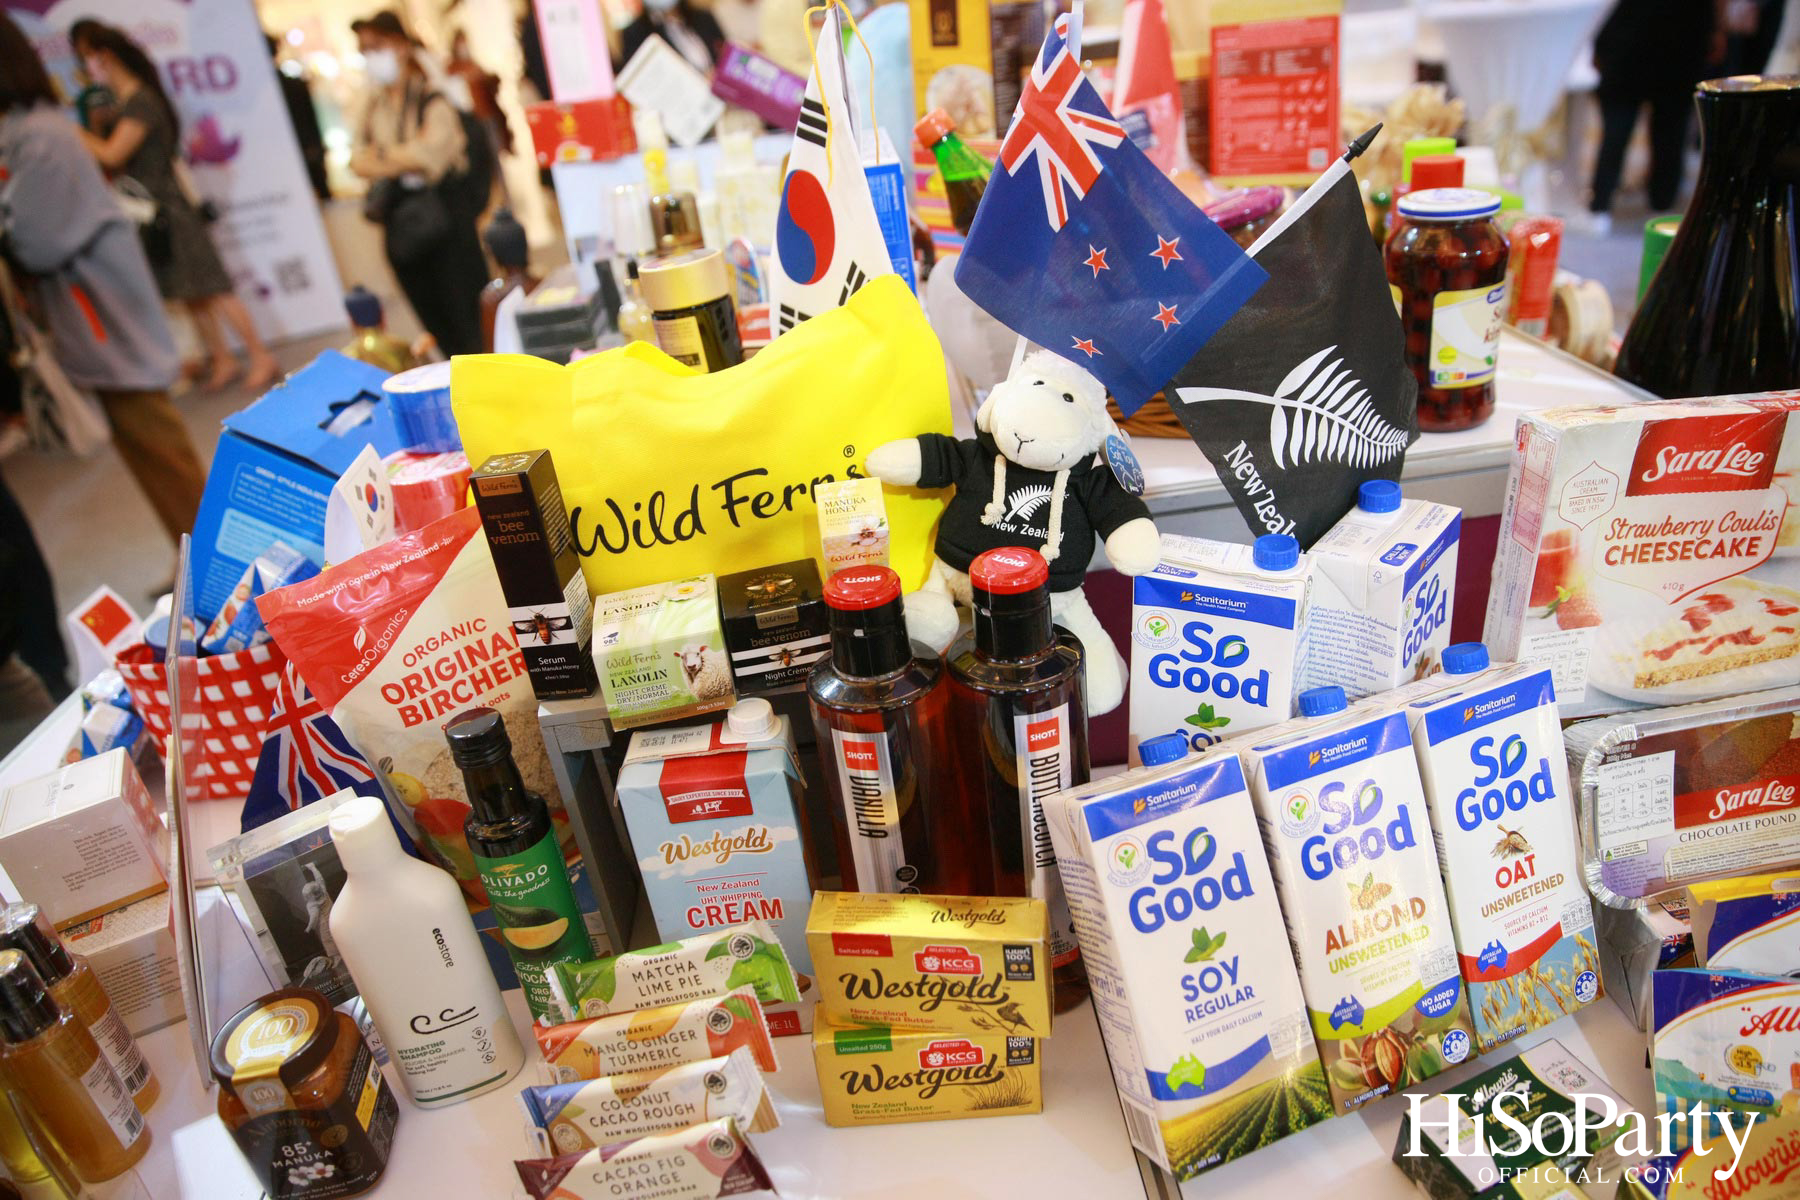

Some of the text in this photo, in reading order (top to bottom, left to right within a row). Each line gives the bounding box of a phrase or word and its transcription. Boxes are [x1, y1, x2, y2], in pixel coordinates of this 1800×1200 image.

[1223, 440, 1267, 497] New
[1642, 441, 1765, 483] Sara Lee
[1572, 478, 1609, 489] AUSTRALIAN
[824, 496, 867, 508] MANUKA
[825, 505, 857, 515] HONEY
[497, 520, 525, 532] bee
[570, 484, 707, 558] Wild
[1604, 509, 1779, 543] Strawberry Coulis
[490, 531, 540, 545] venom
[991, 553, 1028, 568] SHOTT
[1604, 536, 1762, 567] CHEESECAKE
[297, 591, 326, 608] Made
[326, 581, 348, 596] with
[349, 572, 370, 587] care
[381, 558, 403, 573] New
[403, 542, 440, 563] Zealand
[843, 574, 883, 584] SHOTT
[603, 600, 660, 616] LANOLIN
[1195, 593, 1247, 610] Sanitarium
[751, 629, 811, 647] bee venom
[1402, 589, 1448, 669] Good
[402, 617, 488, 668] ORGANIC
[538, 656, 566, 665] Serum
[611, 669, 669, 689] LANOLIN
[765, 669, 787, 681] Night
[1148, 653, 1270, 708] Good
[397, 652, 528, 728] BIRCHER
[488, 691, 511, 707] oats
[614, 688, 641, 698] NIGHT
[1475, 693, 1516, 715] Sanitarium
[1321, 736, 1368, 759] Sanitarium
[1146, 782, 1197, 806] Sanitarium
[1455, 757, 1557, 832] Good
[1708, 780, 1796, 820] Sara Lee
[849, 775, 889, 839] VANILLA
[1679, 812, 1797, 843] CHOCOLATE POUND
[660, 827, 774, 865] Westgold
[1301, 804, 1417, 881] Good
[481, 864, 548, 889] OLIVADO
[1495, 853, 1536, 889] OAT
[503, 888, 518, 898] the
[517, 877, 551, 900] goodness
[697, 877, 761, 894] New Zealand
[1128, 851, 1255, 934] Good
[1481, 873, 1565, 919] UNSWEETENED
[701, 891, 763, 905] UHT WHIPPING
[686, 898, 784, 929] CREAM
[931, 907, 1007, 928] Westgold
[1503, 905, 1549, 930] SOURCE CALCIUM
[1325, 896, 1427, 956] ALMOND
[432, 927, 454, 968] ecostore
[1006, 953, 1031, 961] 100%
[1329, 925, 1431, 975] UNSWEETENED
[643, 953, 678, 967] ORGANIC
[942, 958, 975, 968] KCG
[631, 960, 698, 983] MATCHA
[1180, 955, 1240, 1002] SOY
[638, 974, 703, 997] LIME PIE
[838, 968, 1009, 1012] Westgold
[635, 987, 717, 1009] RAW WHOLEFOOD BAR
[1185, 985, 1256, 1024] REGULAR
[1422, 988, 1455, 1007] NO ADDED
[1428, 1000, 1452, 1014] SUGAR
[870, 1009, 908, 1017] Zealand
[903, 1016, 935, 1024] Butter
[1238, 1010, 1263, 1027] CALCIUM
[257, 1017, 294, 1041] 100
[616, 1024, 653, 1037] ORGANIC
[397, 1040, 446, 1055] HYDRATING
[400, 1047, 442, 1061] SHAMPOO
[583, 1039, 639, 1058] MANGO
[641, 1031, 698, 1049] GINGER
[1008, 1040, 1032, 1048] 100%
[608, 1046, 682, 1068] TURMERIC
[946, 1052, 976, 1062] KCG
[252, 1086, 275, 1100] 100
[614, 1084, 650, 1096] ORGANIC
[600, 1091, 671, 1112] COCONUT
[871, 1101, 908, 1109] Zealand
[589, 1102, 696, 1129] CACAO ROUGH
[604, 1119, 691, 1138] RAW WHOLEFOOD BAR
[271, 1149, 334, 1169] MANUKA
[592, 1154, 686, 1185] CACAO FIG
[614, 1152, 653, 1166] ORGANIC
[610, 1170, 682, 1196] ORANGE
